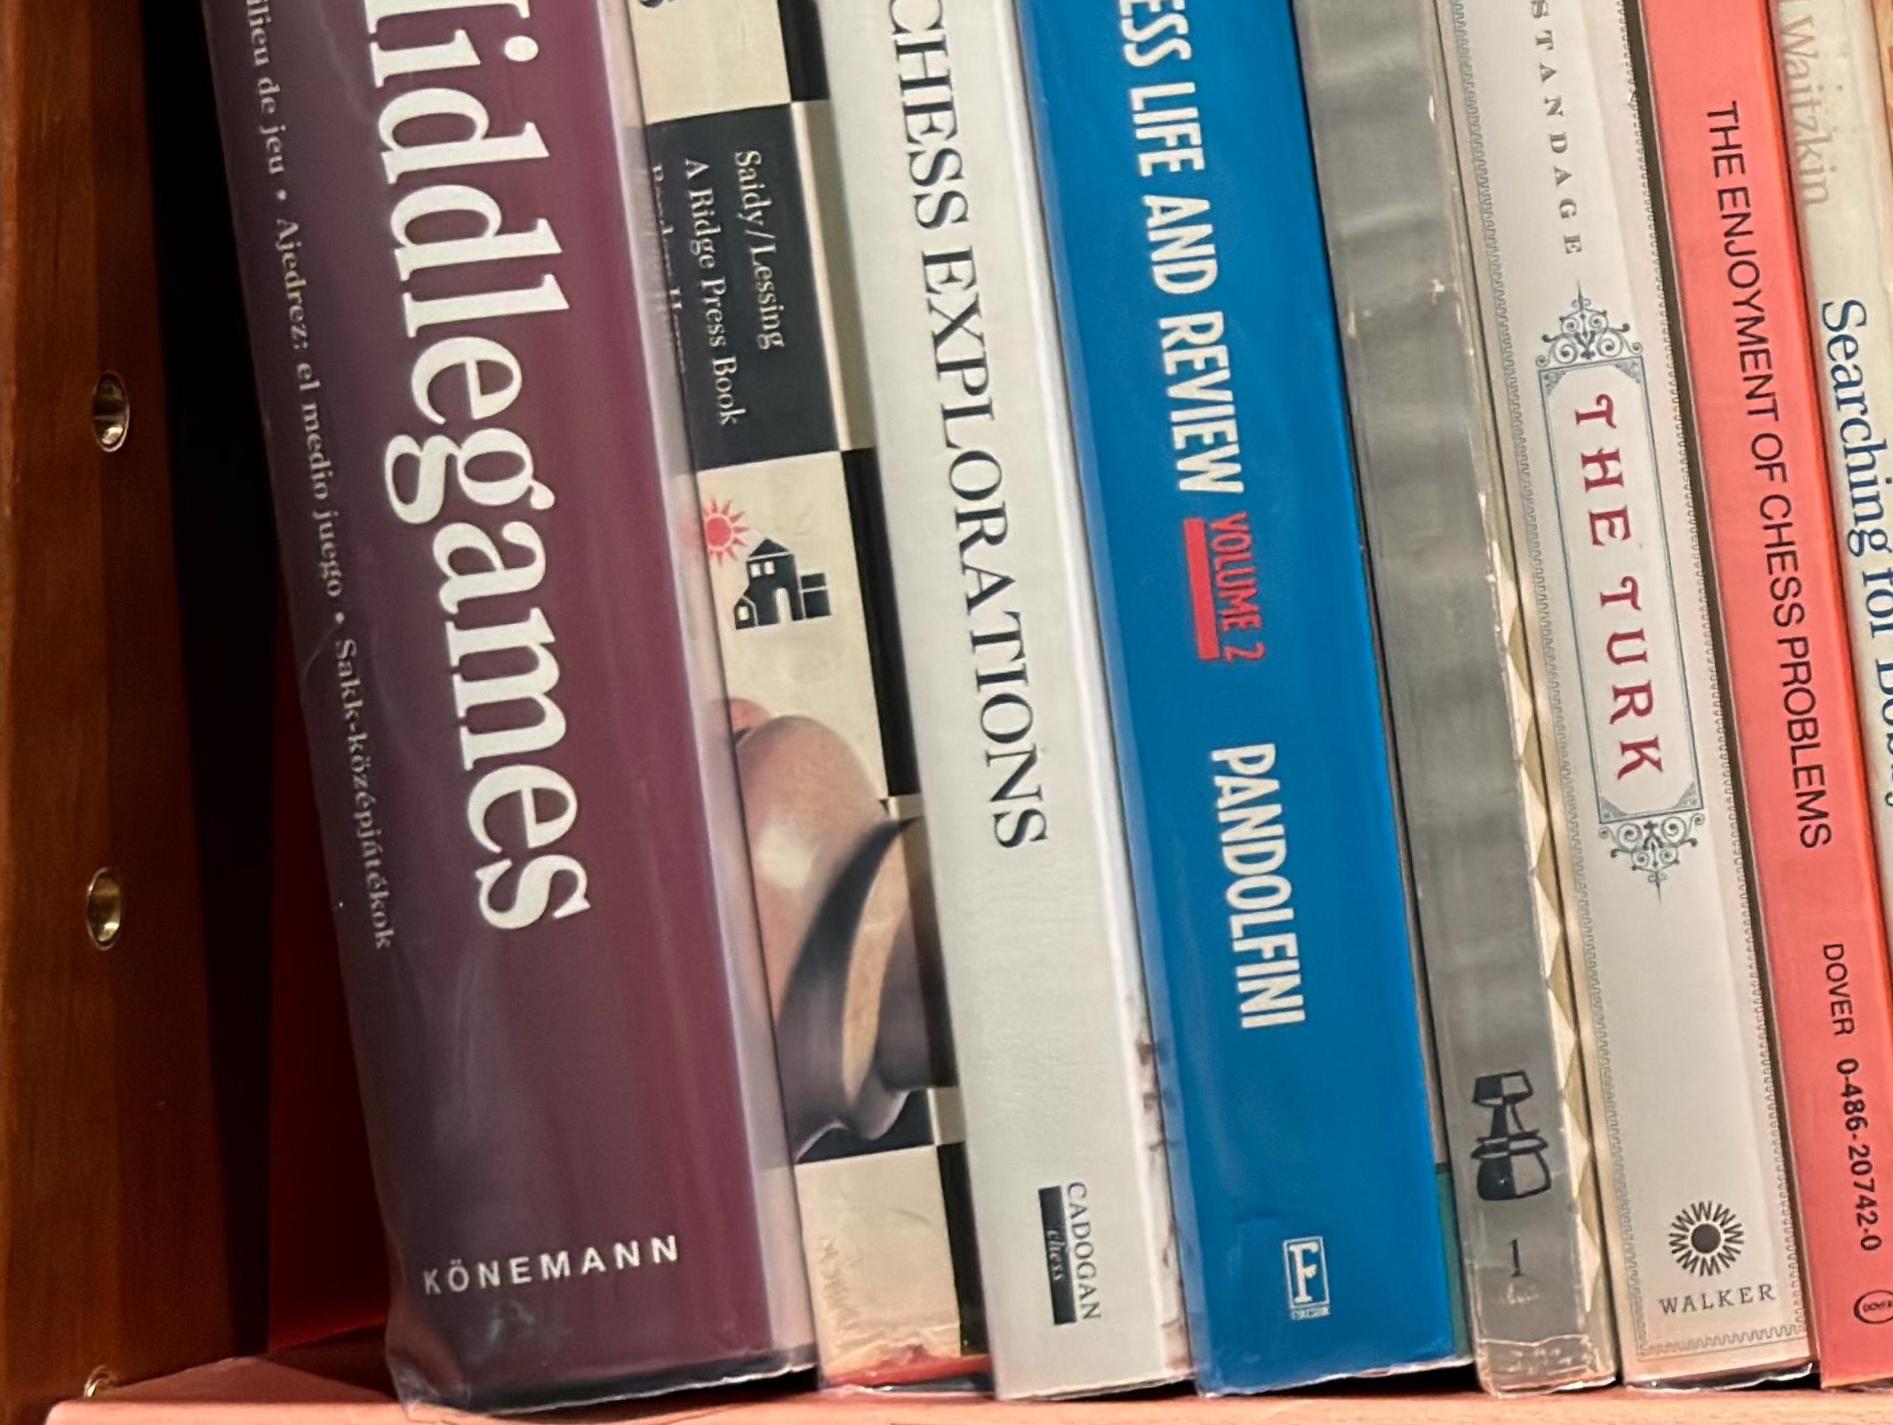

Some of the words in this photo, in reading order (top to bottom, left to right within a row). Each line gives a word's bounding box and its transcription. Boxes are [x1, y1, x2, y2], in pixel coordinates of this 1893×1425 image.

[257, 76, 279, 114] de
[1129, 82, 1205, 177] LIFE
[1531, 0, 1583, 255] STANDAGE
[1707, 101, 1746, 179] THE
[1781, 13, 1838, 207] Waitzkin
[258, 122, 286, 175] jeu
[685, 158, 710, 180] A
[689, 187, 722, 269] Ridge
[735, 150, 785, 351] Saidy/Lessing
[1141, 195, 1218, 295] AND
[276, 217, 311, 350] Ajedrez:
[701, 276, 727, 349] Press
[1717, 186, 1781, 422] ENJOYMENT
[298, 361, 322, 392] el
[712, 356, 747, 426] Book
[1158, 312, 1245, 494] REVIEW
[1821, 299, 1893, 557] Searching
[302, 398, 335, 501] medio
[1574, 393, 1632, 548] THE
[1751, 434, 1788, 484] OF
[312, 510, 343, 597] juego
[922, 245, 1048, 849] EXPLORATIONS
[1206, 511, 1263, 633] VOLUME
[1760, 495, 1805, 628] CHESS
[1223, 642, 1268, 662] 2
[1600, 576, 1663, 780] TURK
[1778, 637, 1833, 849] PROBLEMS
[1210, 743, 1307, 1029] PANDOLFINI
[1823, 943, 1855, 1037] DOVER
[1836, 1058, 1884, 1253] 0-486-20742-0
[423, 1234, 680, 1296] KÖNEMANN
[1067, 1181, 1103, 1320] CADOGAN
[1658, 1284, 1777, 1316] WALKER
